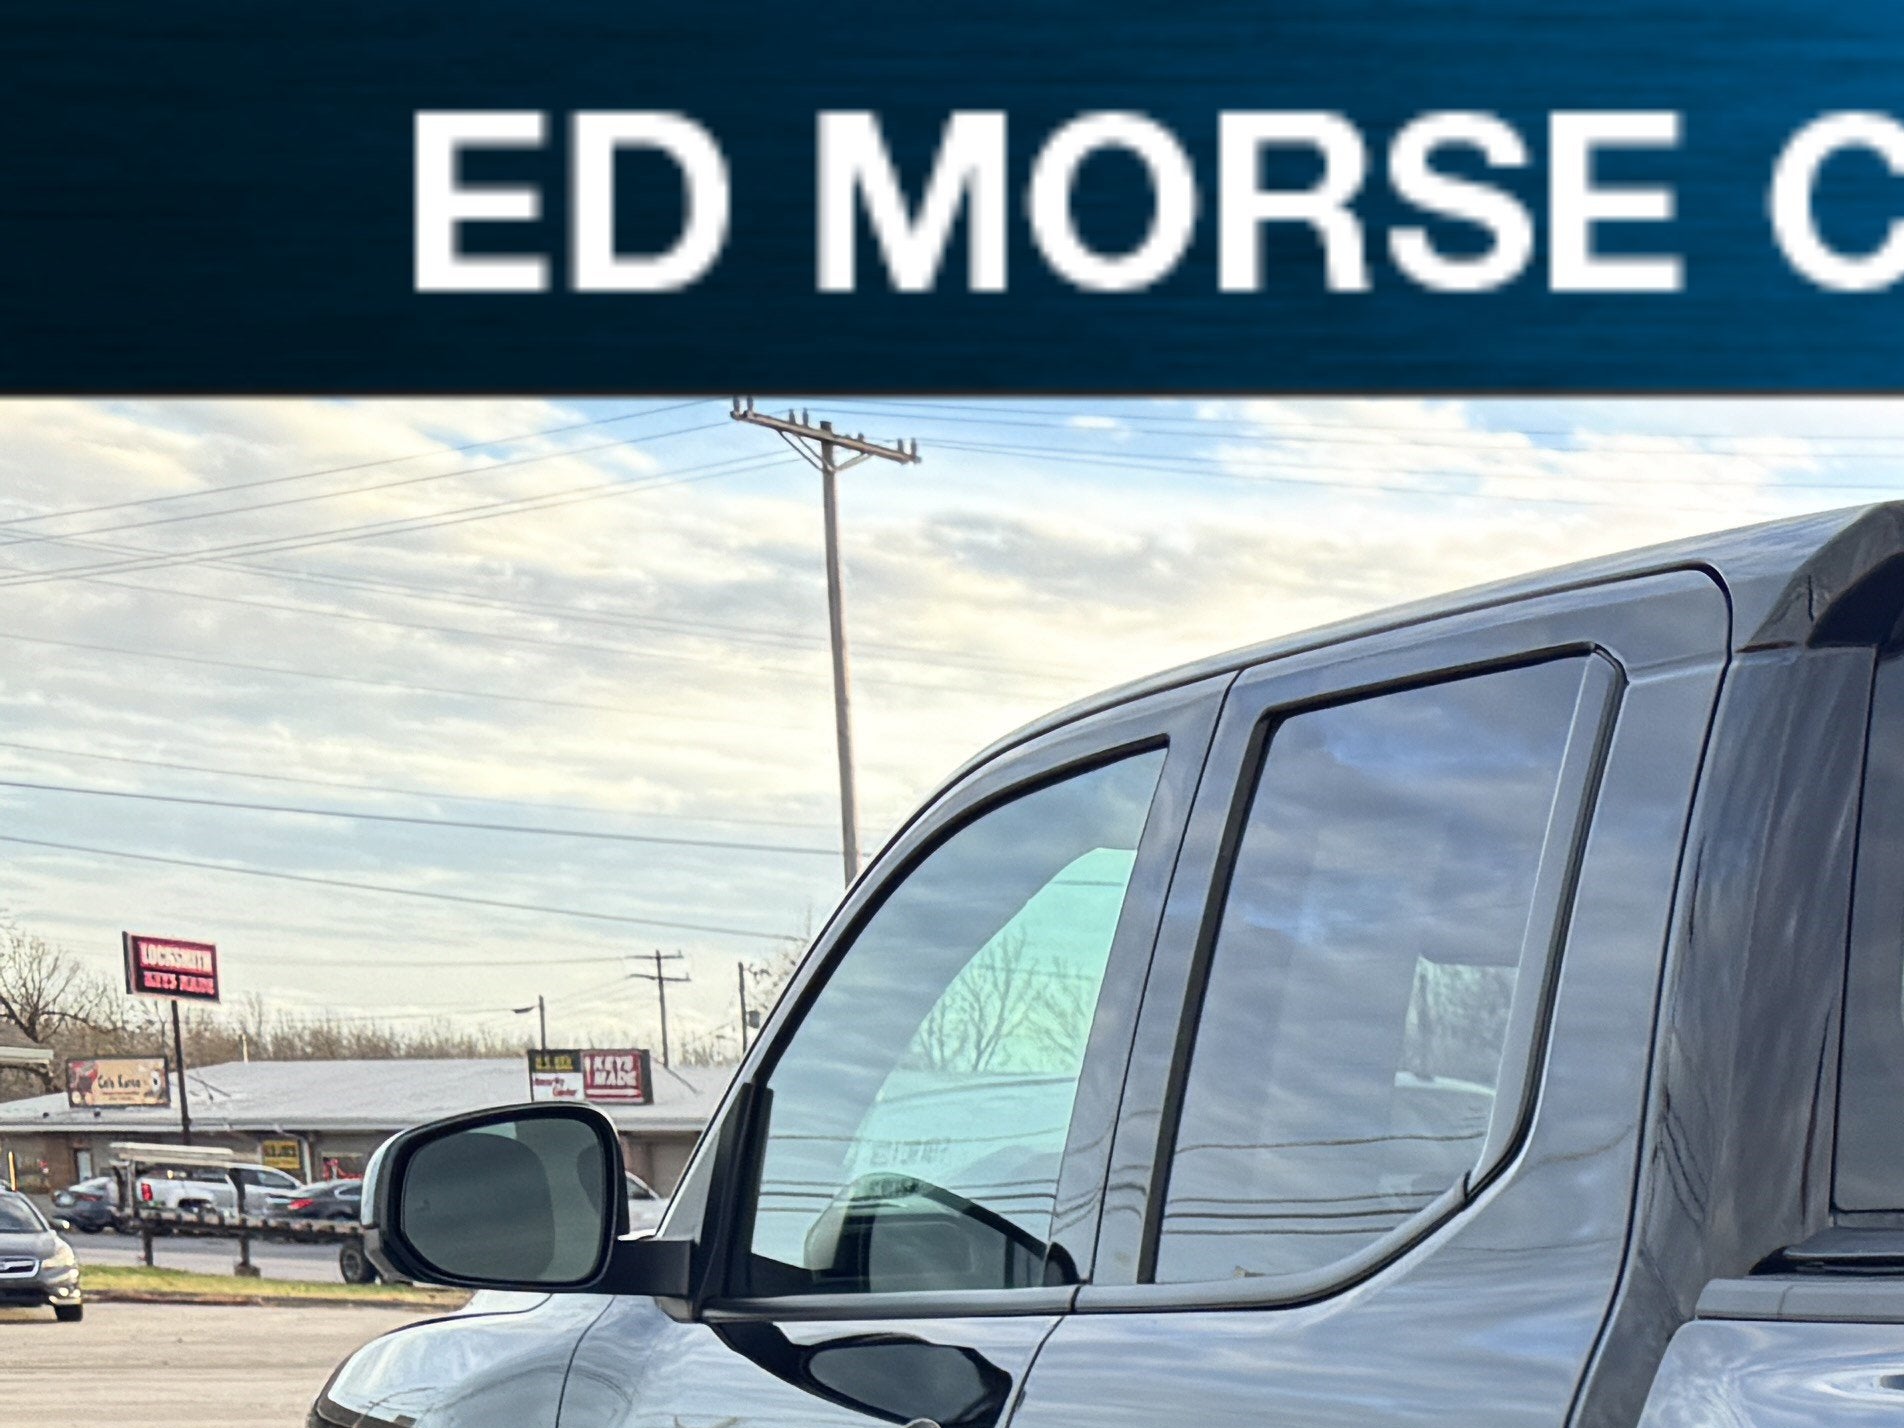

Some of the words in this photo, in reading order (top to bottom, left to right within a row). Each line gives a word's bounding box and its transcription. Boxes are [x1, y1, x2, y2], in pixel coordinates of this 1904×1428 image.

[137, 941, 214, 977] LOCKSMITH
[143, 970, 178, 991] KEYS
[593, 1055, 634, 1074] KEYS
[593, 1069, 637, 1087] MADE
